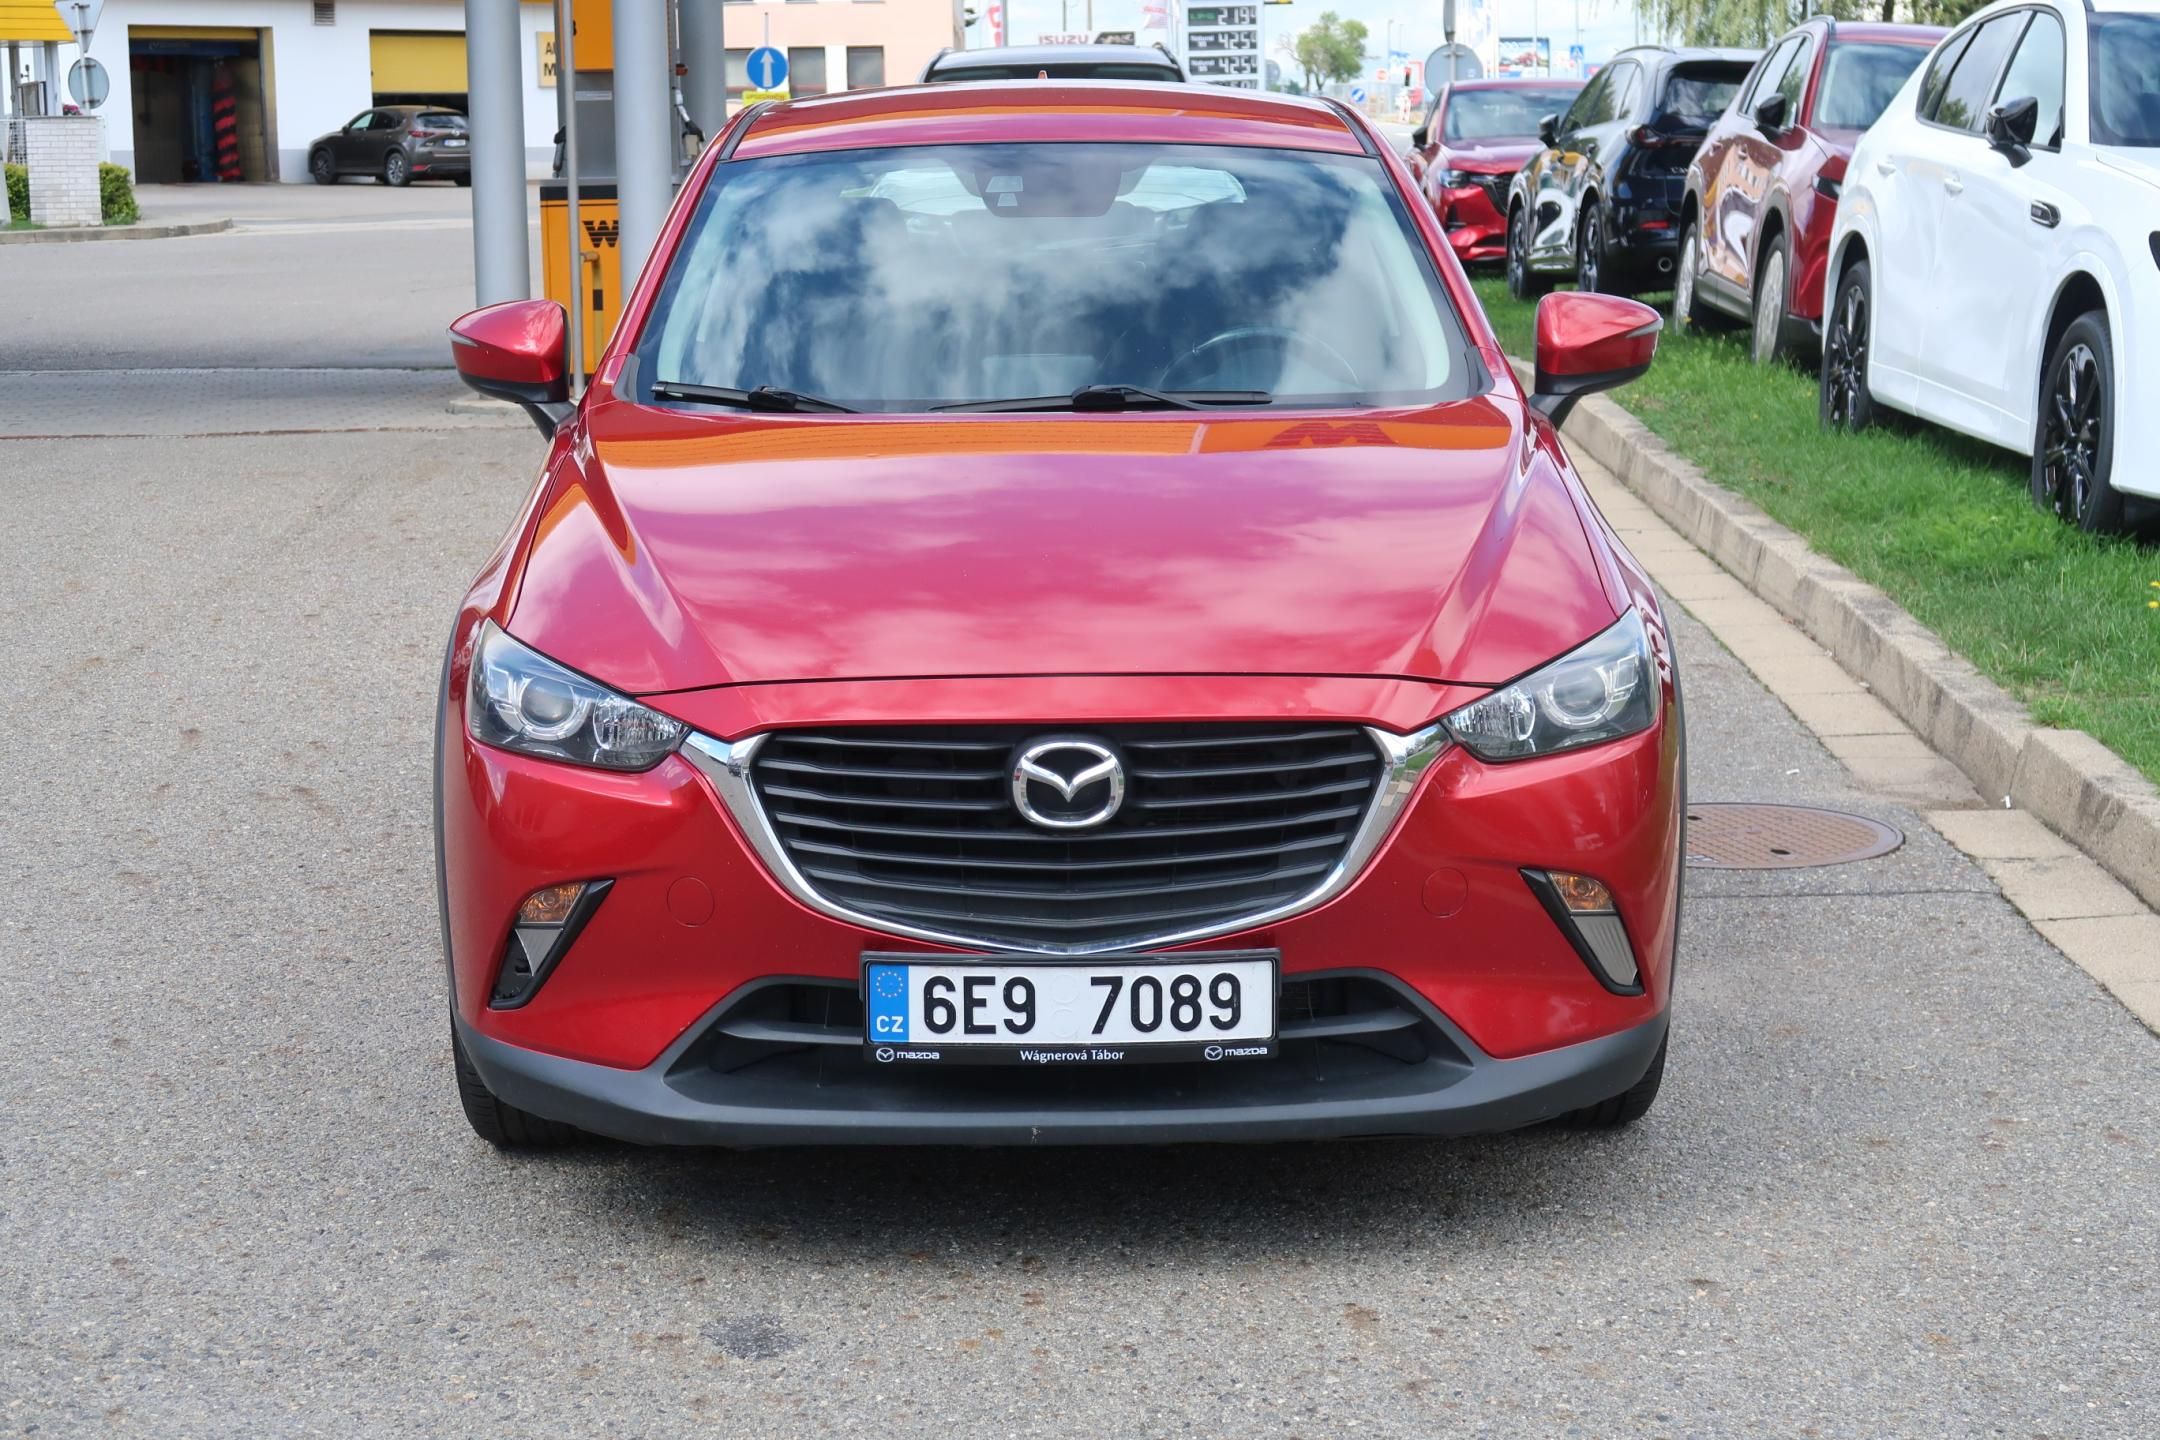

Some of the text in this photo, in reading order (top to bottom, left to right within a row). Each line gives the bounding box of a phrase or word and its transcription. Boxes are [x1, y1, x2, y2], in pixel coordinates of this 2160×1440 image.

[1039, 35, 1089, 45] ISUZU
[923, 972, 1241, 1035] 6E9 7089
[876, 1015, 904, 1033] CZ
[1020, 1049, 1125, 1063] Wágnerová Tábor
